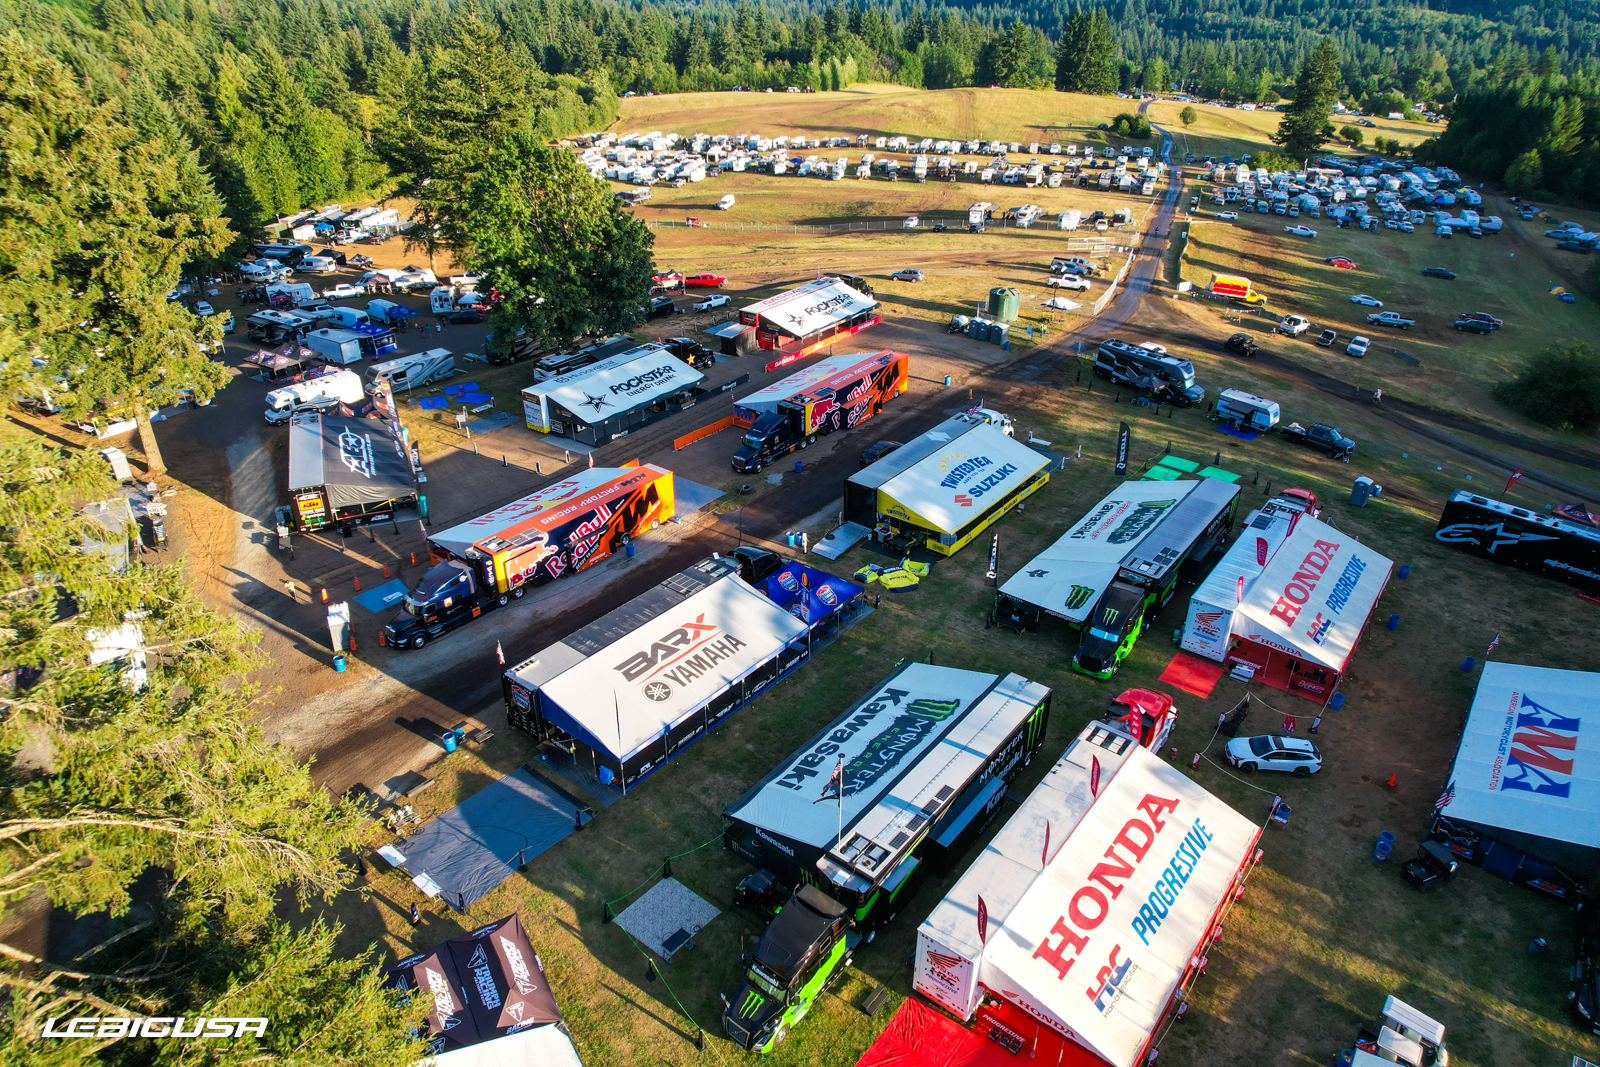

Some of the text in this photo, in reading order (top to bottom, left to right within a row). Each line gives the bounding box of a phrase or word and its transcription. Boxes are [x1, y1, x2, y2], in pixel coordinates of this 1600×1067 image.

[804, 293, 854, 316] ROCKSTAR
[609, 365, 677, 395] ROCKSTAR
[774, 355, 795, 368] GASGAS
[626, 374, 677, 397] ENERGY DRINK
[1118, 430, 1128, 463] SCOTT
[941, 456, 994, 489] TWISTED TEA
[968, 463, 1018, 497] SUZUKI
[468, 481, 580, 526] Red Bull
[540, 473, 647, 525] KTM FACTORY RACING
[1070, 500, 1124, 540] Kawasaki
[1269, 539, 1341, 628] HONDA
[1325, 553, 1367, 615] PROGRESSIVE
[613, 612, 718, 682] BARX
[663, 633, 748, 687] YAMAHA
[1260, 635, 1304, 658] HONDA
[775, 688, 910, 791] Kawasaki
[843, 718, 930, 791] MONSTER
[844, 727, 900, 775] ENERGY
[1488, 691, 1519, 790] AMERICAN MOTORCYCLIST ASSOCIATION
[1501, 692, 1581, 798] AMA
[755, 826, 794, 857] Kawasaki
[1032, 793, 1180, 981] HONDA
[1130, 817, 1214, 947] PROGRESSIVE
[474, 968, 493, 1010] RACING
[481, 964, 501, 1008] TRIUMPH
[751, 963, 780, 988] Kawasaki
[925, 972, 958, 995] PROGRESSIVE
[926, 957, 961, 983] HONDA
[1085, 943, 1133, 1014] HRC
[506, 1016, 534, 1034] RACING
[983, 1013, 1026, 1043] PROGRESSIVE
[1018, 996, 1077, 1039] HONDA
